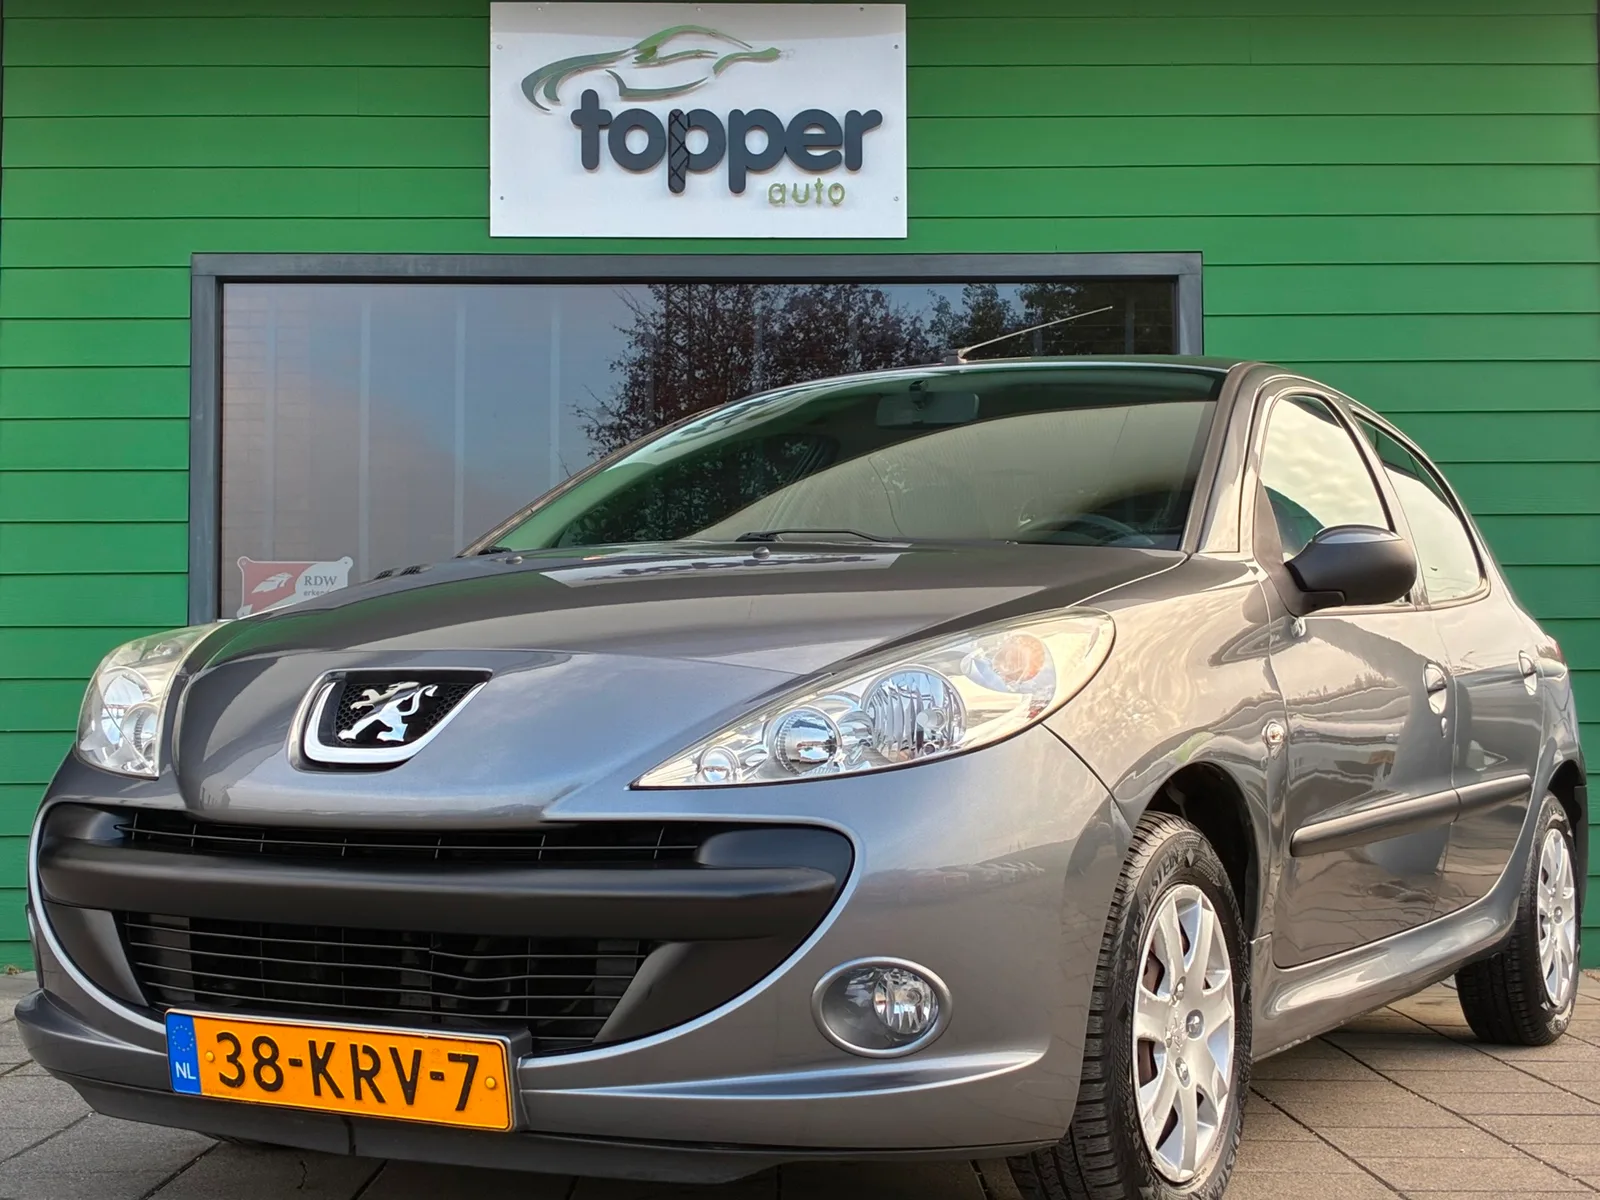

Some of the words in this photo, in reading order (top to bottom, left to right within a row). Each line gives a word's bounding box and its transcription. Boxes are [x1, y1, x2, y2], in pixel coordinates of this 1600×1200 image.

[570, 89, 883, 194] topper
[768, 178, 845, 205] auto
[303, 575, 338, 587] RDW
[175, 1061, 197, 1080] NL
[216, 1031, 479, 1111] 38-KRV-7
